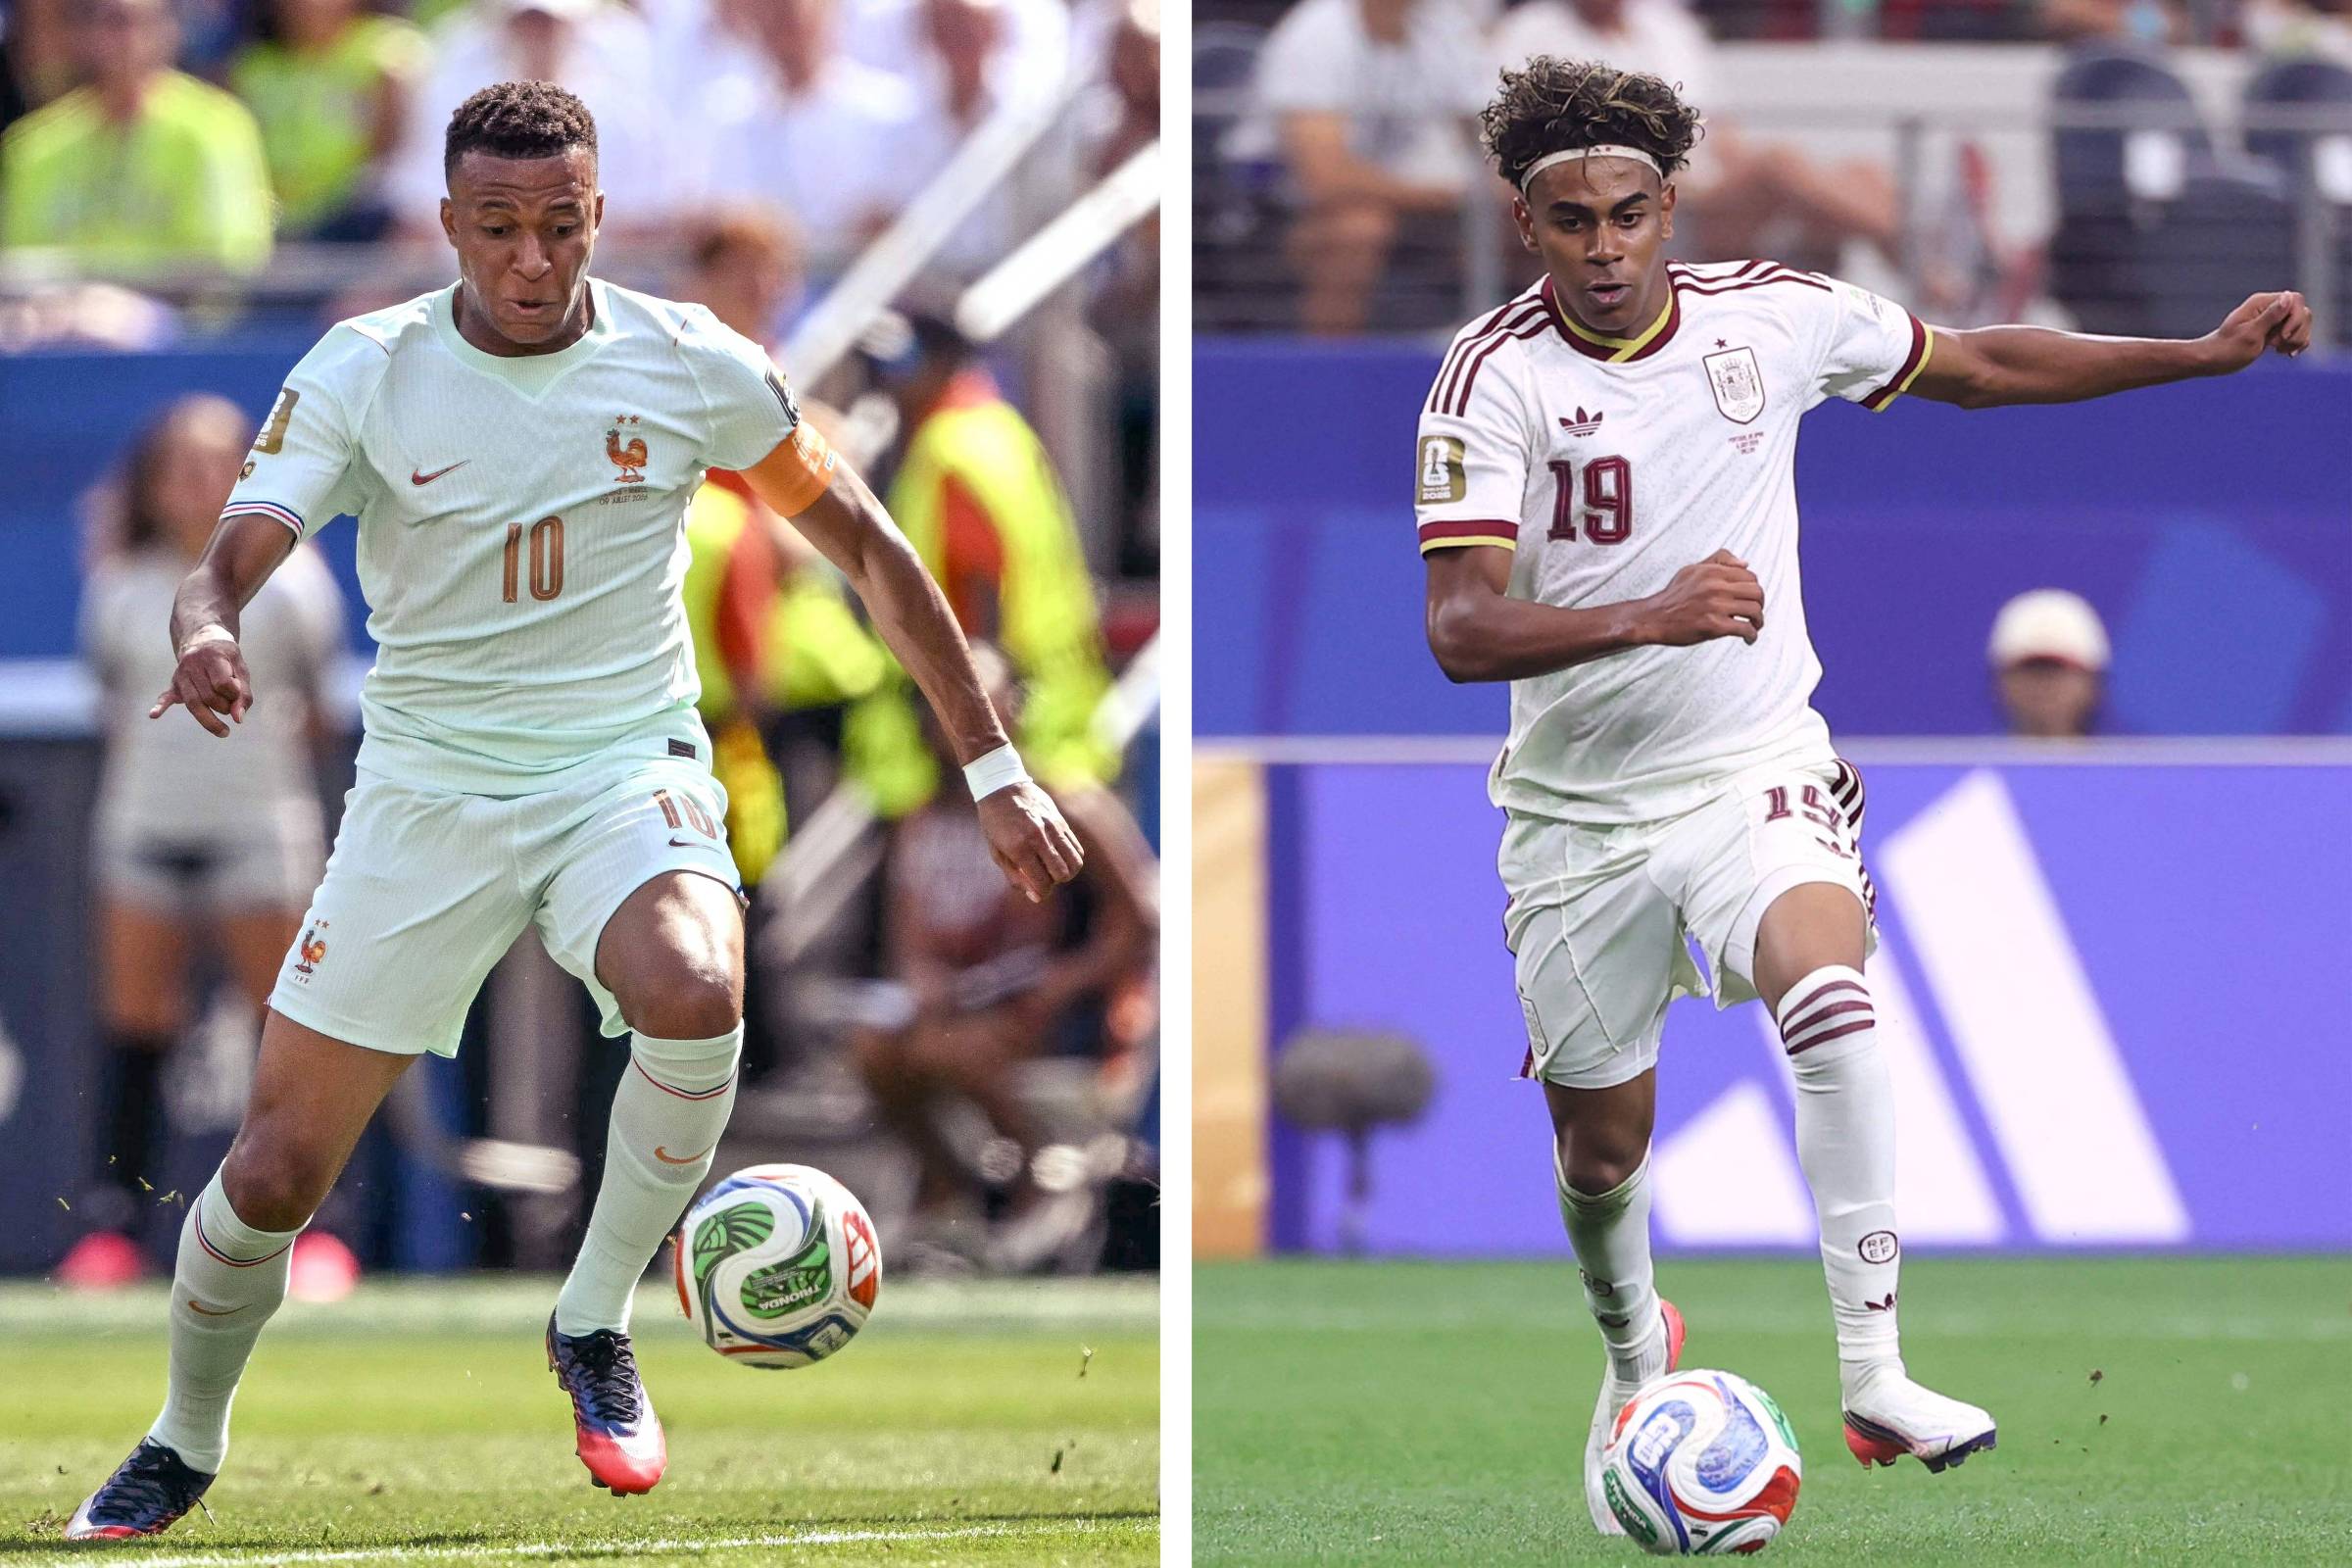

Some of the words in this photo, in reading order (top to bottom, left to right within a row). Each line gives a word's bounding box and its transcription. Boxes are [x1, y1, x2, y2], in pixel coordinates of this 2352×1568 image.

[1546, 455, 1632, 545] 19
[503, 515, 564, 603] 10
[653, 788, 717, 840] 10
